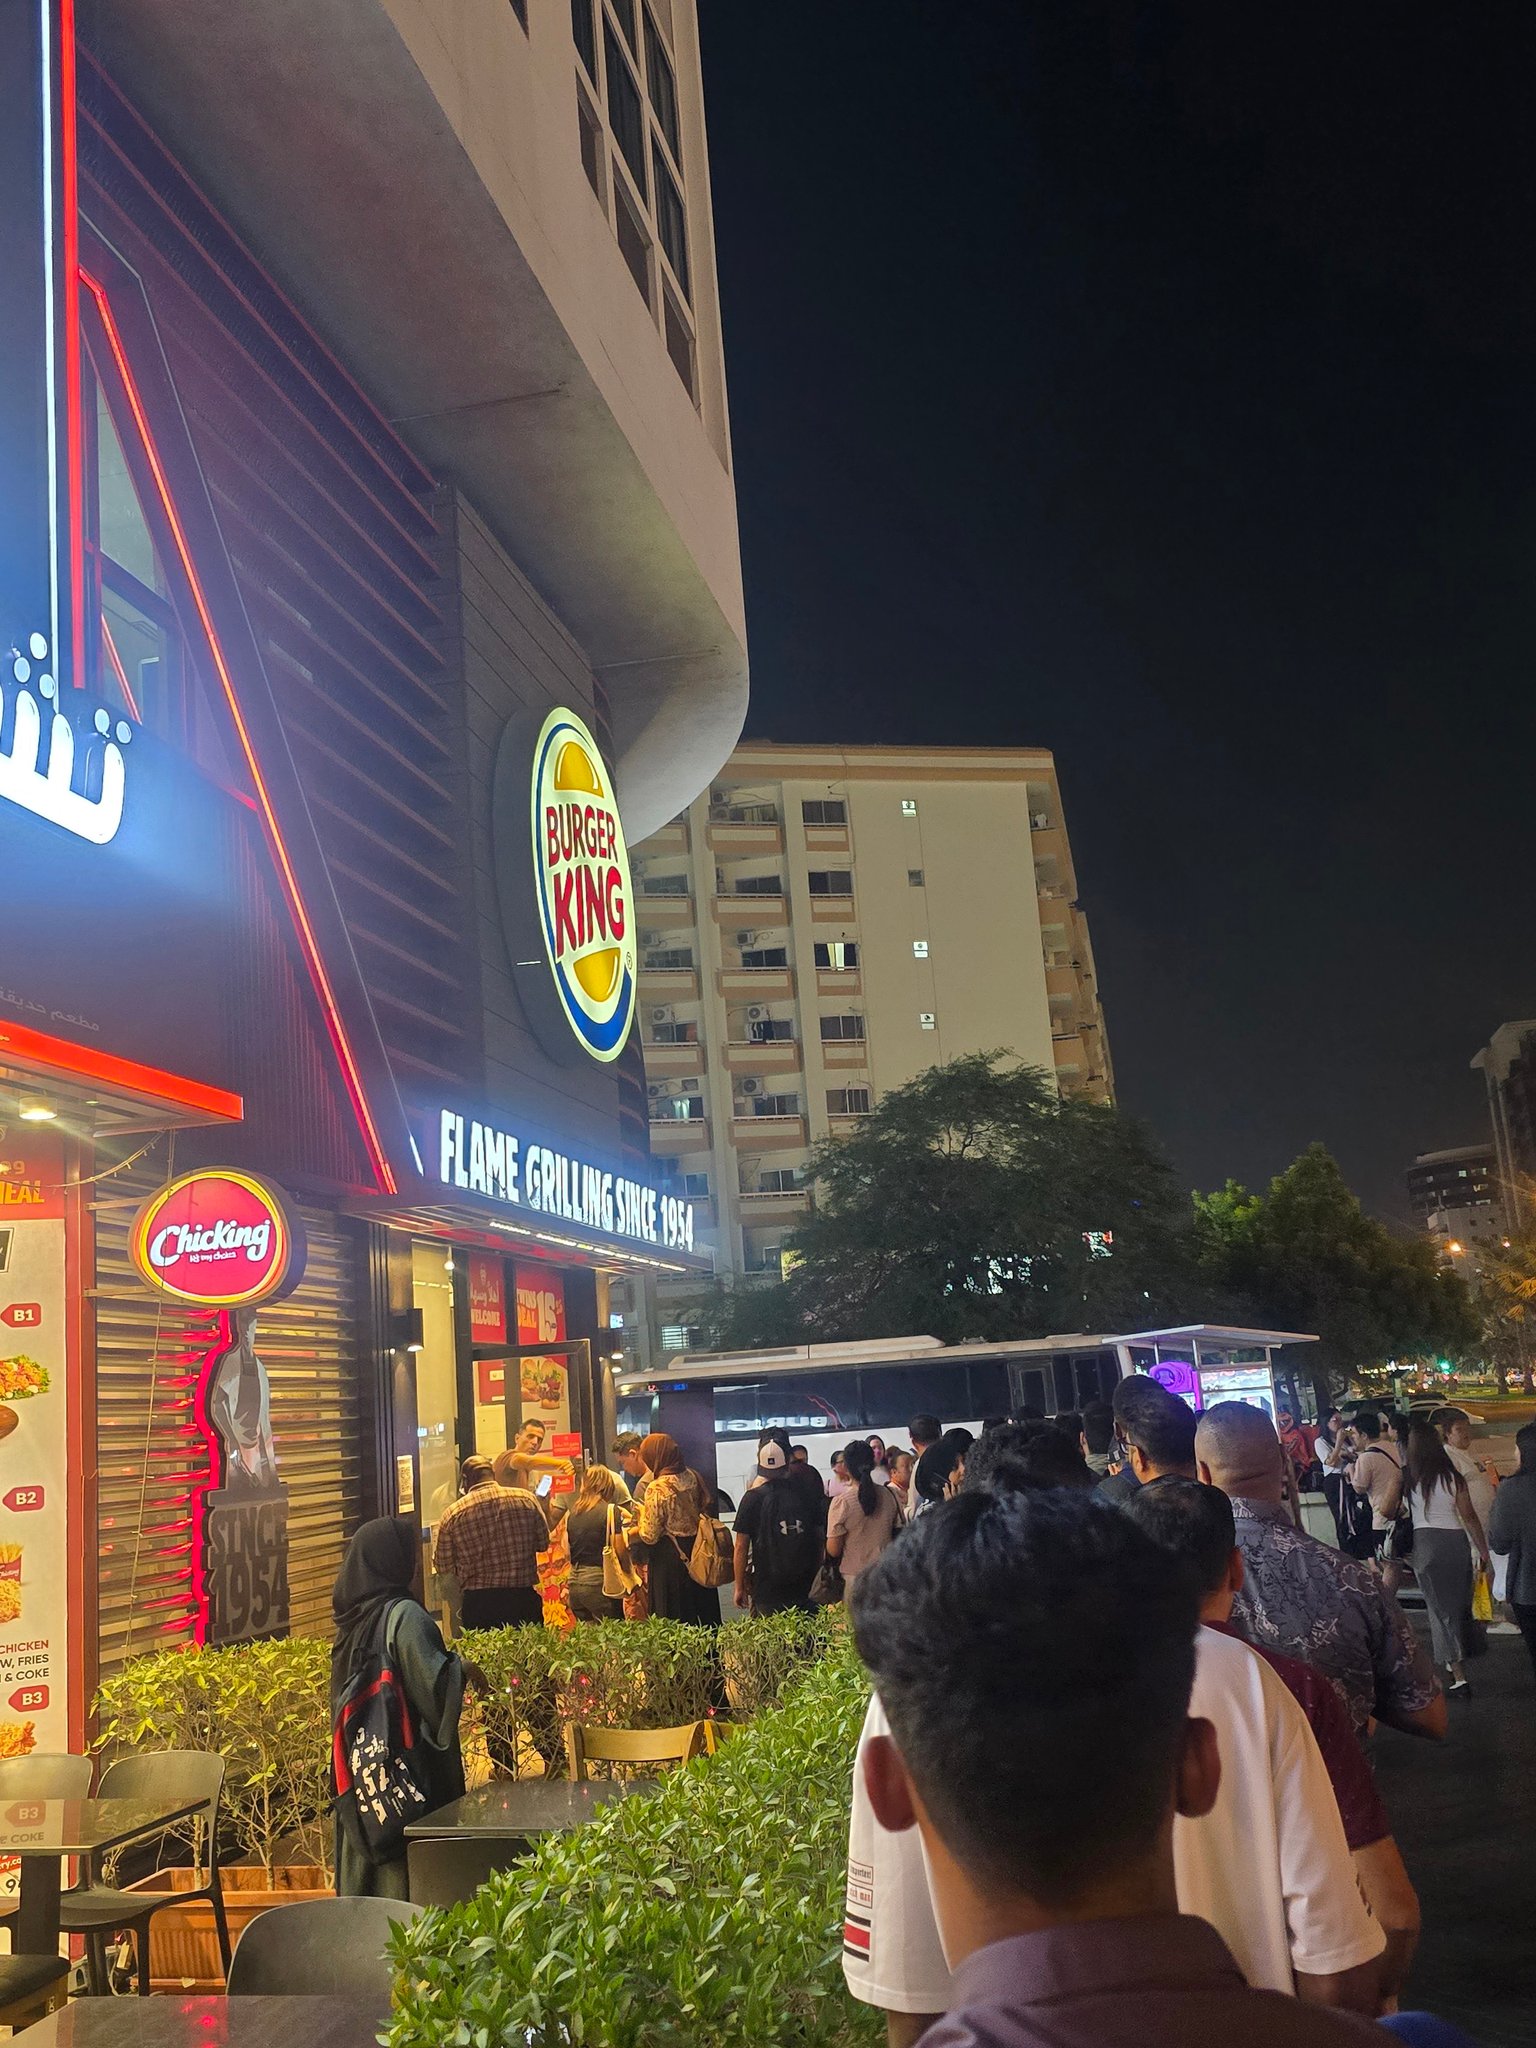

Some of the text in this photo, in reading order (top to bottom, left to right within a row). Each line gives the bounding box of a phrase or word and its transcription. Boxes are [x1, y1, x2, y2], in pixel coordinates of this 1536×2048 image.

[546, 803, 618, 867] BURGER
[553, 865, 625, 957] KING
[51, 1011, 99, 1031] مطعم
[440, 1109, 694, 1252] FLAME GRILLING SINCE 1954
[150, 1220, 270, 1266] Chicking
[13, 1309, 35, 1322] B1
[471, 1309, 501, 1327] WELCOME
[15, 1492, 37, 1505] B2
[208, 1503, 289, 1567] SINCE
[209, 1555, 290, 1638] 1954
[0, 1640, 49, 1655] CHICKEN
[18, 1654, 49, 1667] FRIES
[4, 1668, 49, 1683] & COKE
[22, 1692, 43, 1706] B3
[0, 1857, 21, 1870] ry.co
